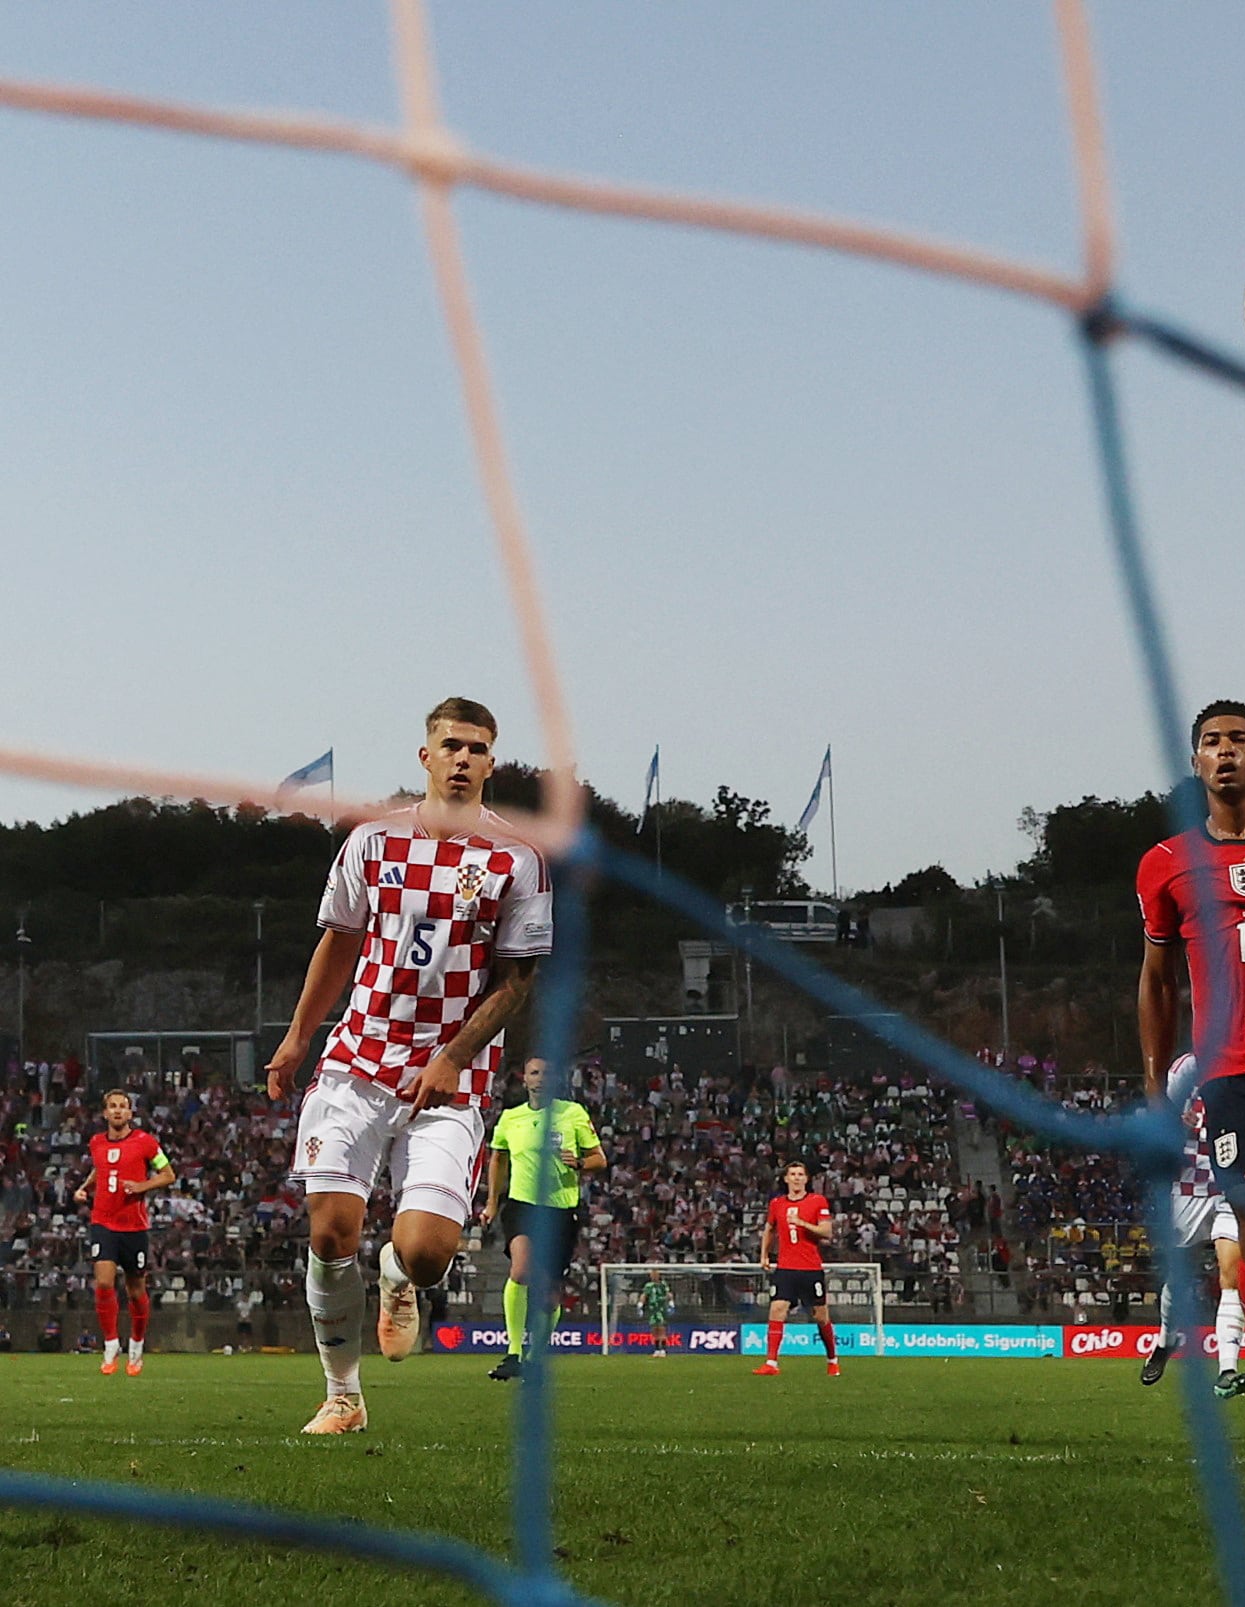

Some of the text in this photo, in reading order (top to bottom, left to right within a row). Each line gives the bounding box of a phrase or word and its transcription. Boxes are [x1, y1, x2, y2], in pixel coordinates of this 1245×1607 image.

[411, 922, 436, 966] 5
[108, 1175, 118, 1193] 9
[137, 1251, 145, 1269] 9
[815, 1282, 823, 1297] 8
[547, 1331, 582, 1346] RCE
[689, 1330, 737, 1350] PSK
[904, 1334, 979, 1350] Udobnije,
[984, 1334, 1055, 1351] Sigurnije
[1071, 1329, 1123, 1354] Chio
